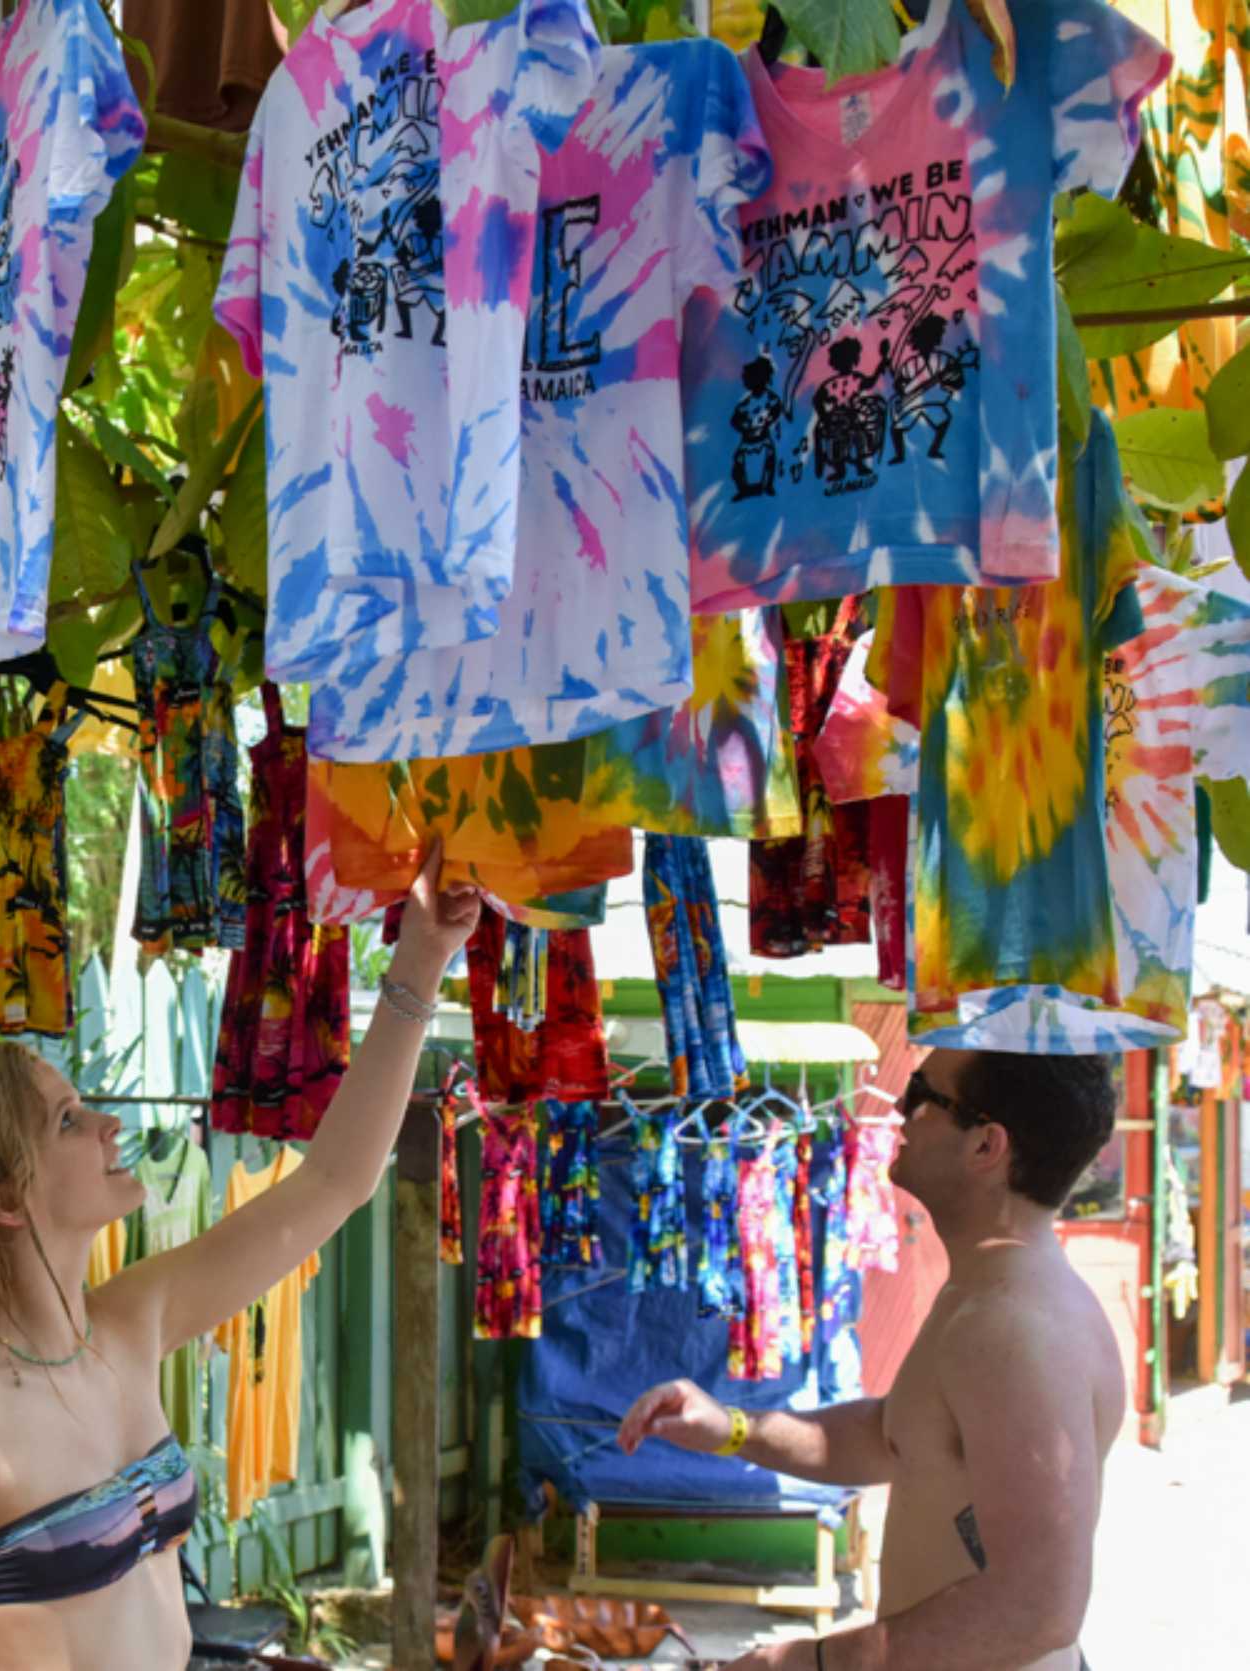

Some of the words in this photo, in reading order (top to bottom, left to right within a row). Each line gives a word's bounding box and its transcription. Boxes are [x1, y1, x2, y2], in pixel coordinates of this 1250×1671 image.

[870, 172, 913, 205] WE
[926, 159, 963, 189] BE
[520, 371, 597, 401] AMAICA
